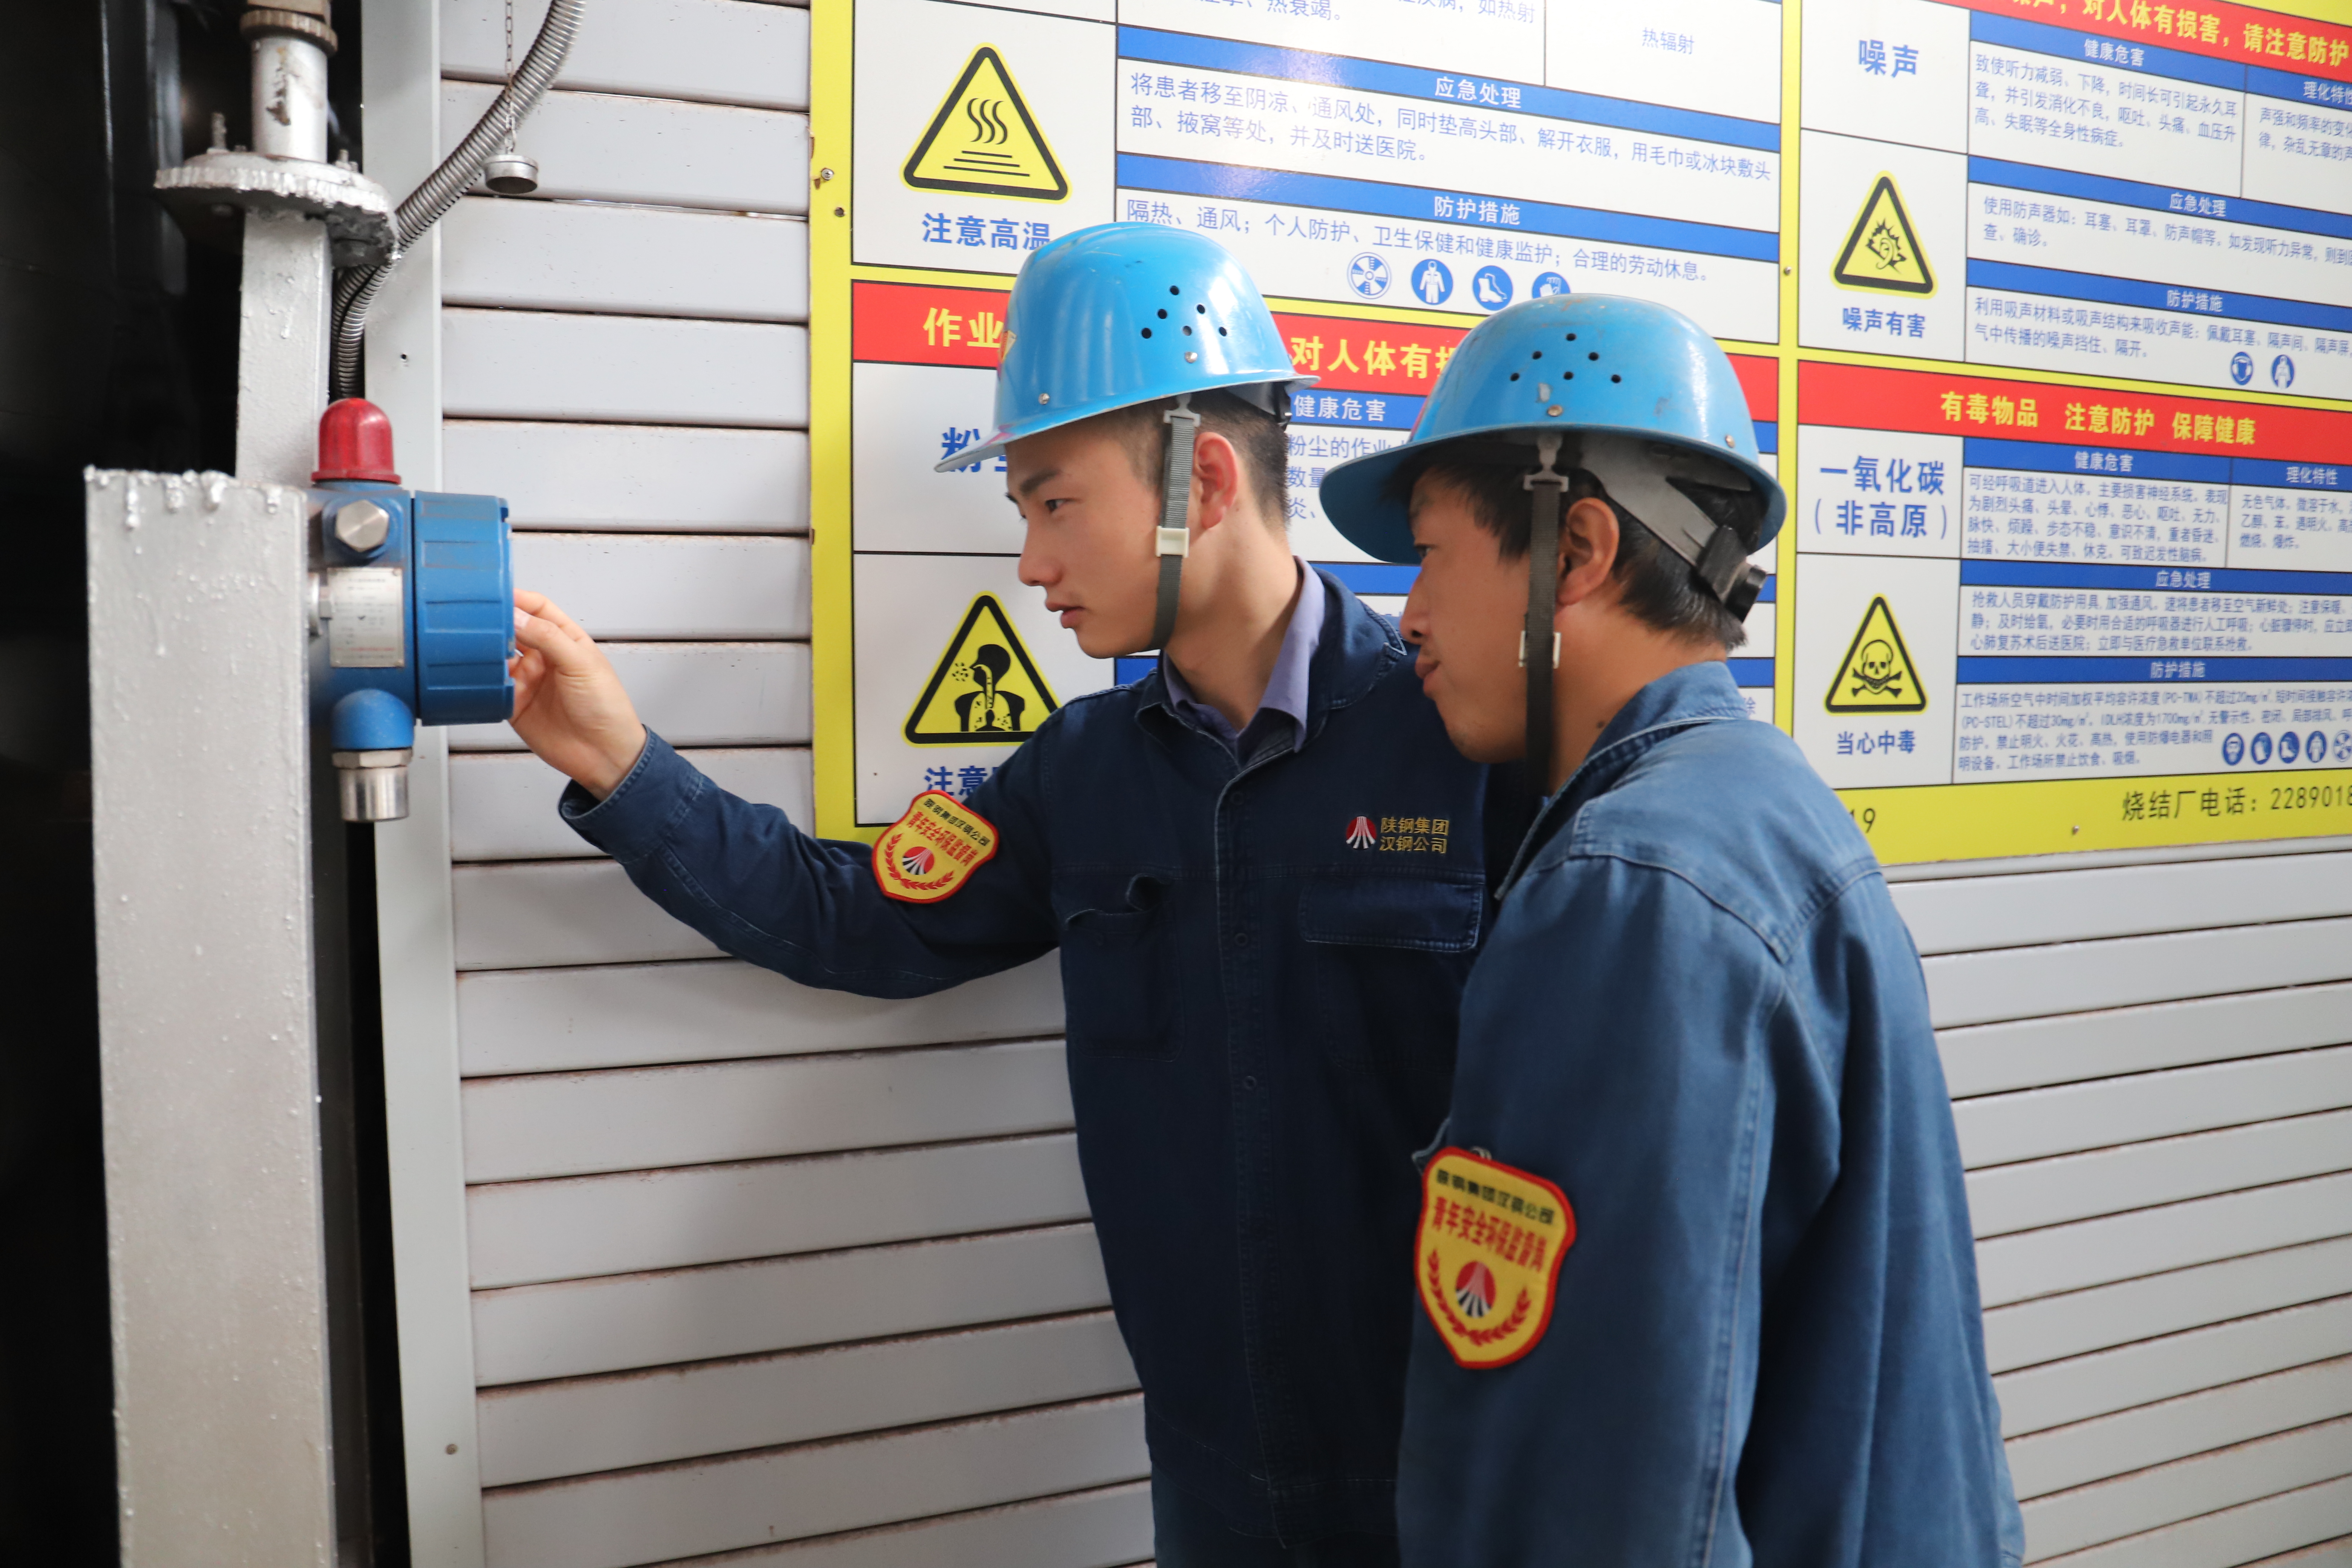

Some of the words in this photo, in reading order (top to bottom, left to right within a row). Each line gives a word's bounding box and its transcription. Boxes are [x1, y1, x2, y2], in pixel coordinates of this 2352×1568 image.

[1642, 27, 1695, 55] 热辐射
[2084, 38, 2145, 67] 健康危害
[1858, 39, 1919, 78] 噪声
[1435, 76, 1522, 109] 应急处理
[1434, 196, 1521, 226] 防护措施
[2169, 192, 2226, 217] 应急处理
[922, 213, 1050, 250] 注意高温
[2167, 289, 2223, 312] 防护措施
[1842, 307, 1925, 338] 噪声有害
[1294, 395, 1386, 422] 健康危害
[1940, 391, 2038, 428] 有毒物品
[2064, 403, 2154, 436] 注意防护
[2172, 411, 2256, 445] 保障健康
[2074, 450, 2133, 472] 健康危害
[1820, 455, 1945, 495] 一氧化碳
[2286, 466, 2338, 485] 理化特性
[2156, 570, 2211, 589] 应急处理
[2150, 661, 2206, 678] 防护措施
[1836, 729, 1916, 755] 当心中毒
[923, 765, 1000, 796] 注意
[1380, 816, 1449, 836] 陕钢集团
[1849, 808, 1876, 833] 9
[1379, 835, 1448, 854] 汉钢公司
